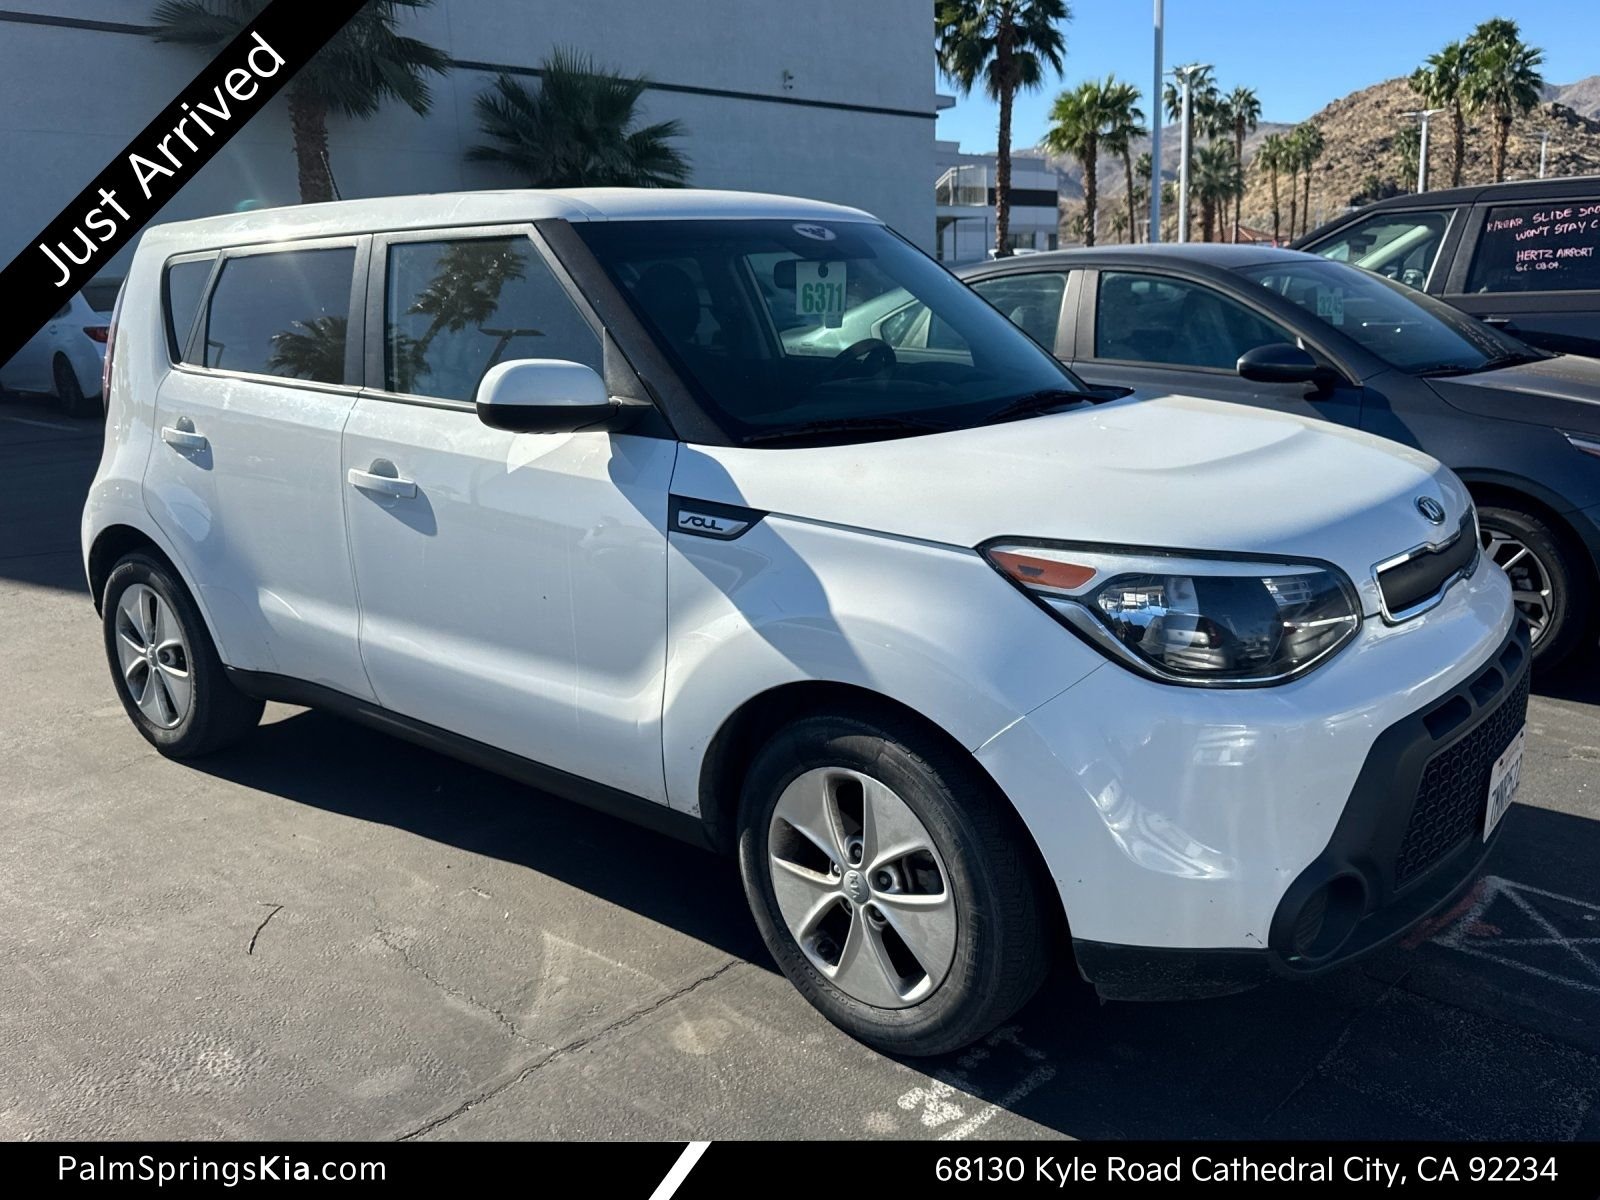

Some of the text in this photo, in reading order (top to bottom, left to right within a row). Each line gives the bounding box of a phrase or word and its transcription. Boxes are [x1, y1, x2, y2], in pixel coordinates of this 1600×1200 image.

[1533, 207, 1573, 224] SLIDE
[1515, 226, 1550, 241] WON'T
[1554, 221, 1586, 234] STAY
[1516, 247, 1594, 262] HERTZ AIRPORT
[802, 282, 842, 313] 6371
[680, 516, 723, 531] SOUL
